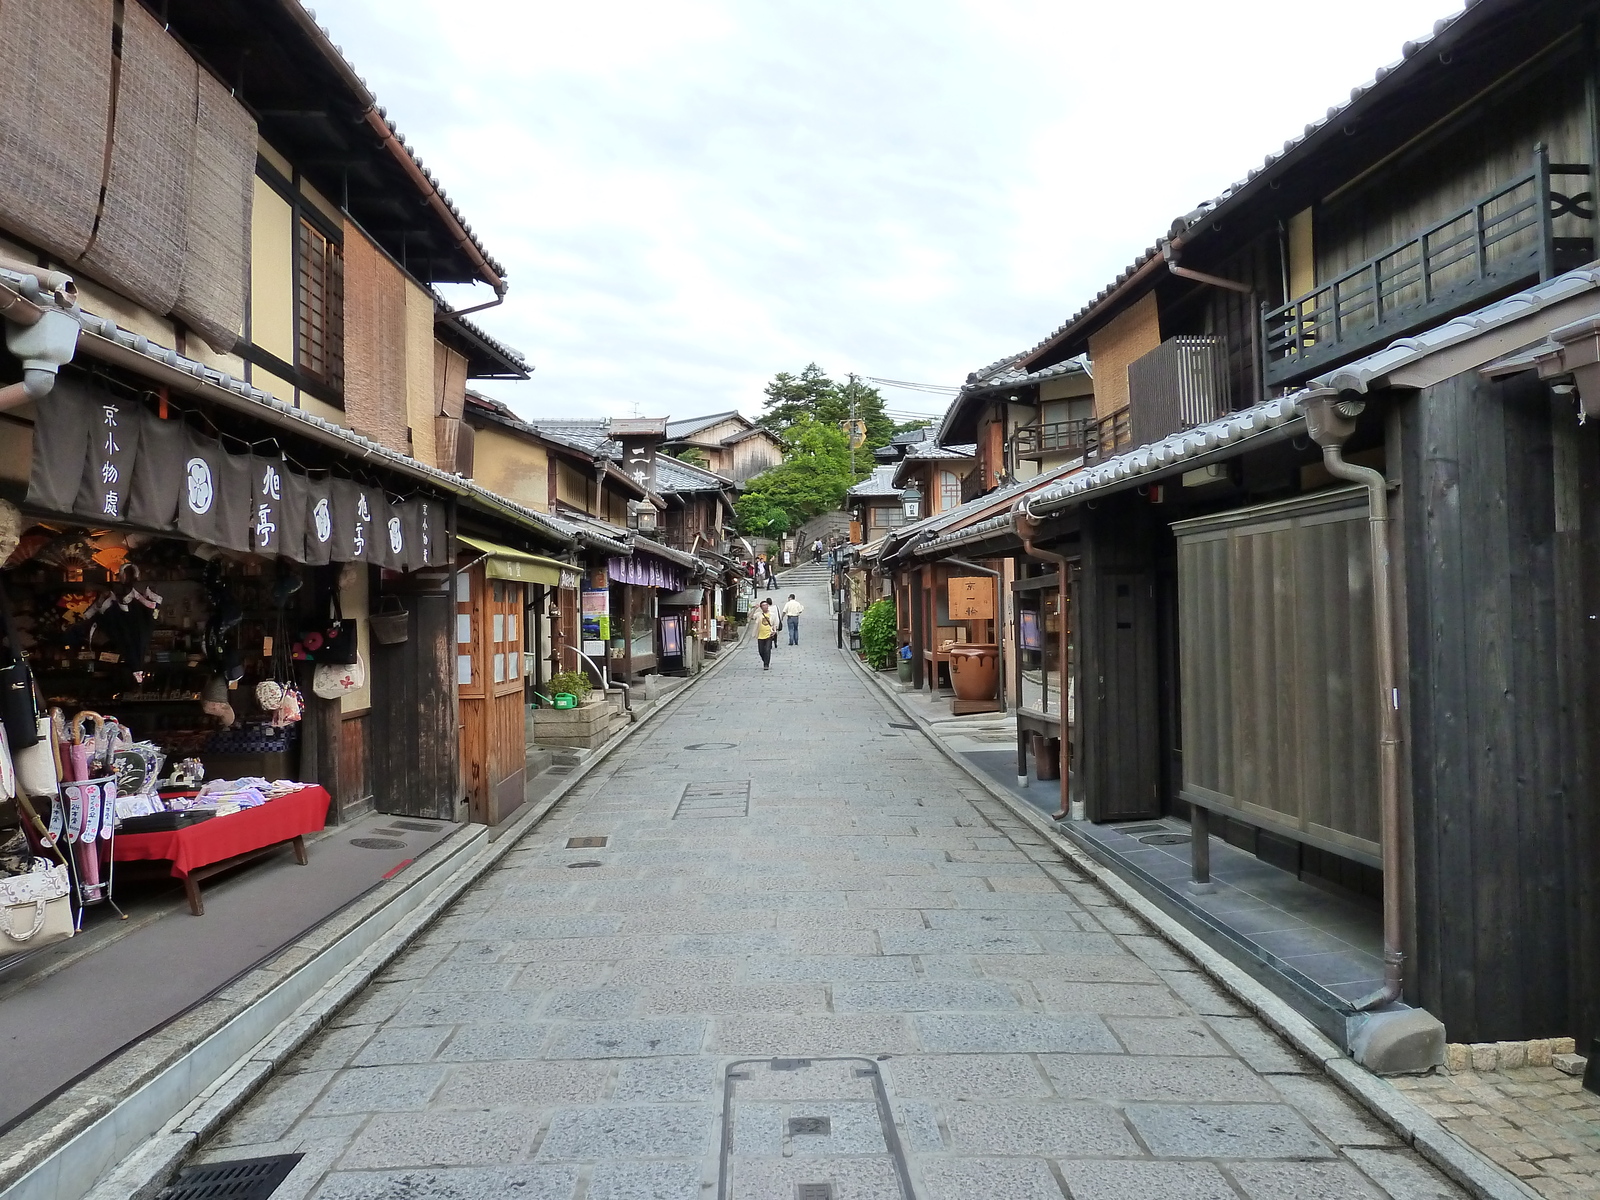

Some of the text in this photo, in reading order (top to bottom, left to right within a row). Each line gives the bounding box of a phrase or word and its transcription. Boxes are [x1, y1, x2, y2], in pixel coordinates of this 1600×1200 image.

[102, 403, 119, 517] 京小物處
[256, 464, 281, 548] 旭亭
[353, 492, 371, 556] 旭亭
